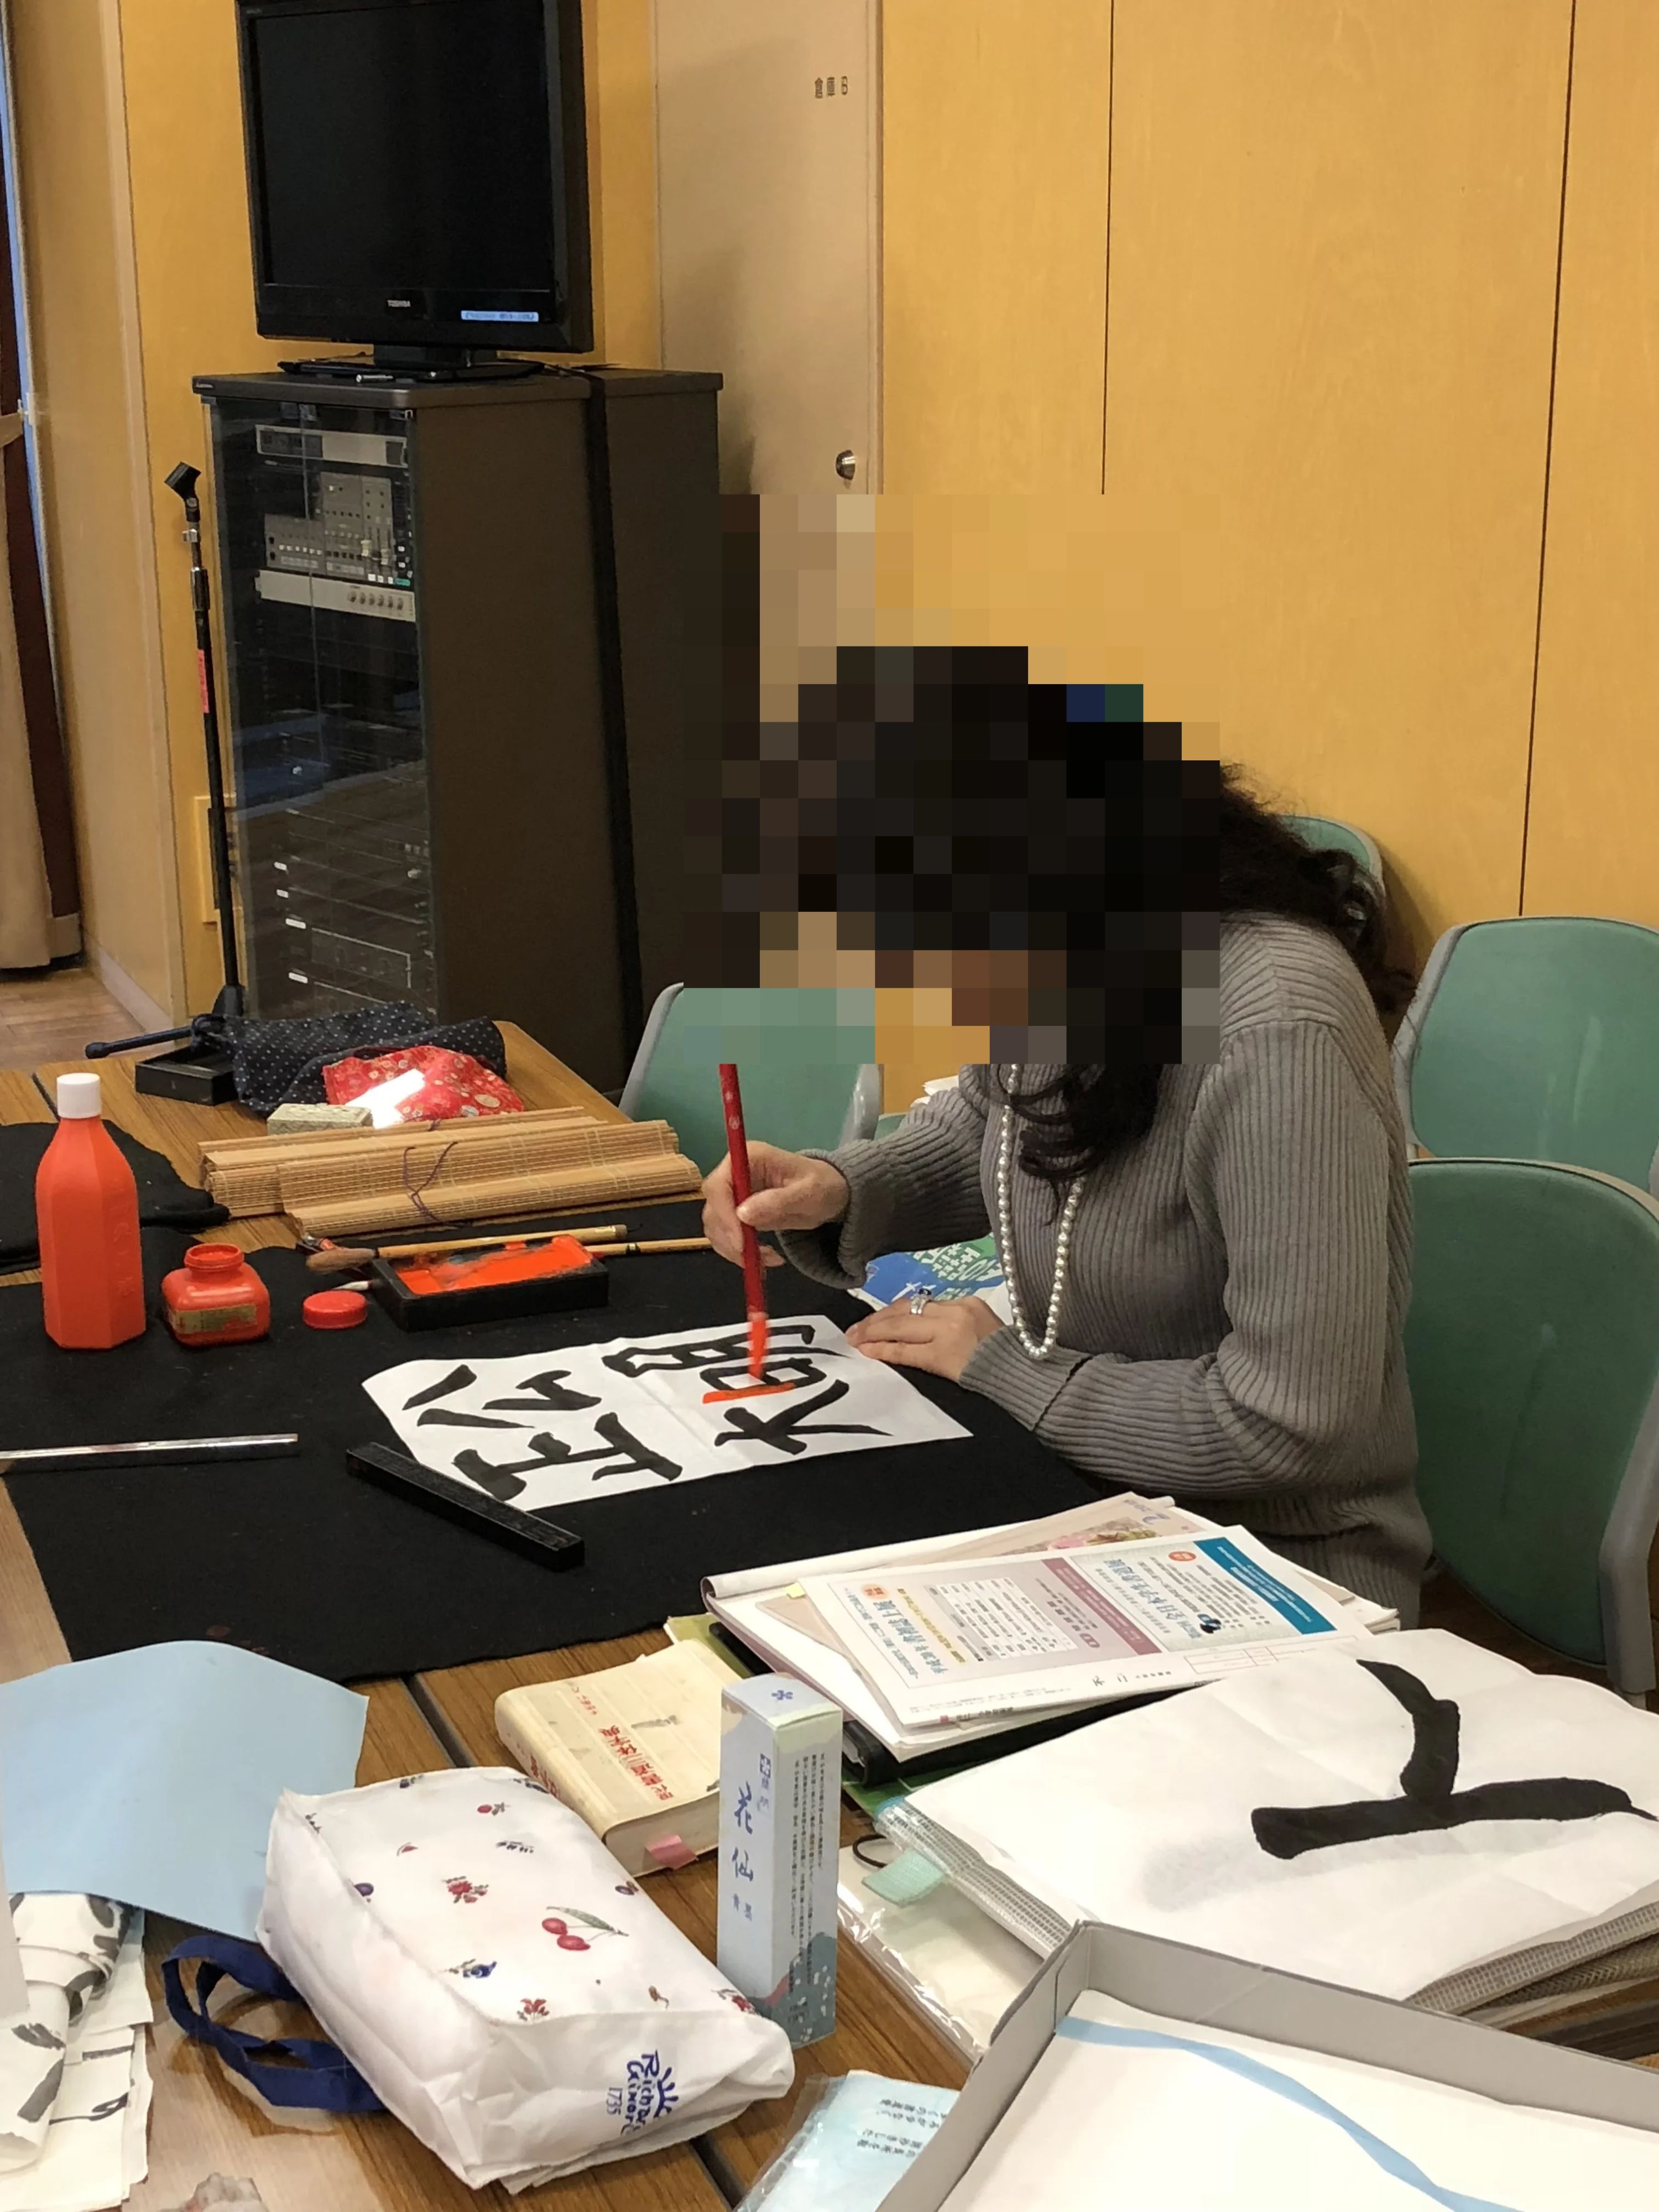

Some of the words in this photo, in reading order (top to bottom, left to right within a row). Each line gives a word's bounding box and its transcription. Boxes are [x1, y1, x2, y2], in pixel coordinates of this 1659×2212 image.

[387, 299, 411, 307] TOSHIBA
[732, 1780, 754, 1882] 花仙
[607, 2086, 623, 2116] 1735
